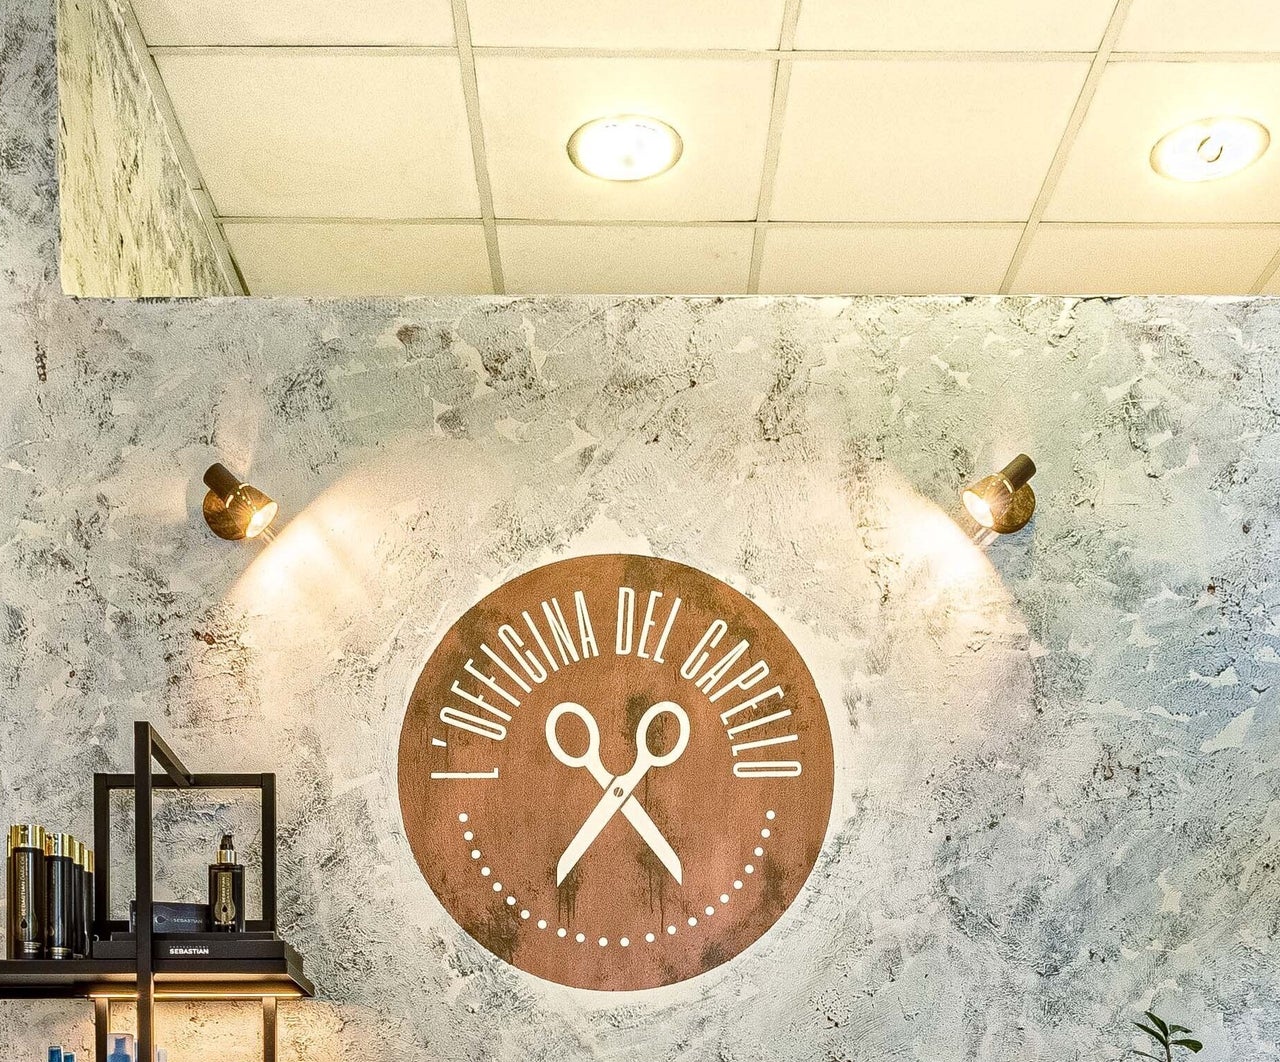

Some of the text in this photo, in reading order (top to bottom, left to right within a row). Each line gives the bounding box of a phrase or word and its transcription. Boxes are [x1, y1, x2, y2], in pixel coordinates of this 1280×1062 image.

[431, 586, 803, 779] L'OFFICINA DEL CAPELLO
